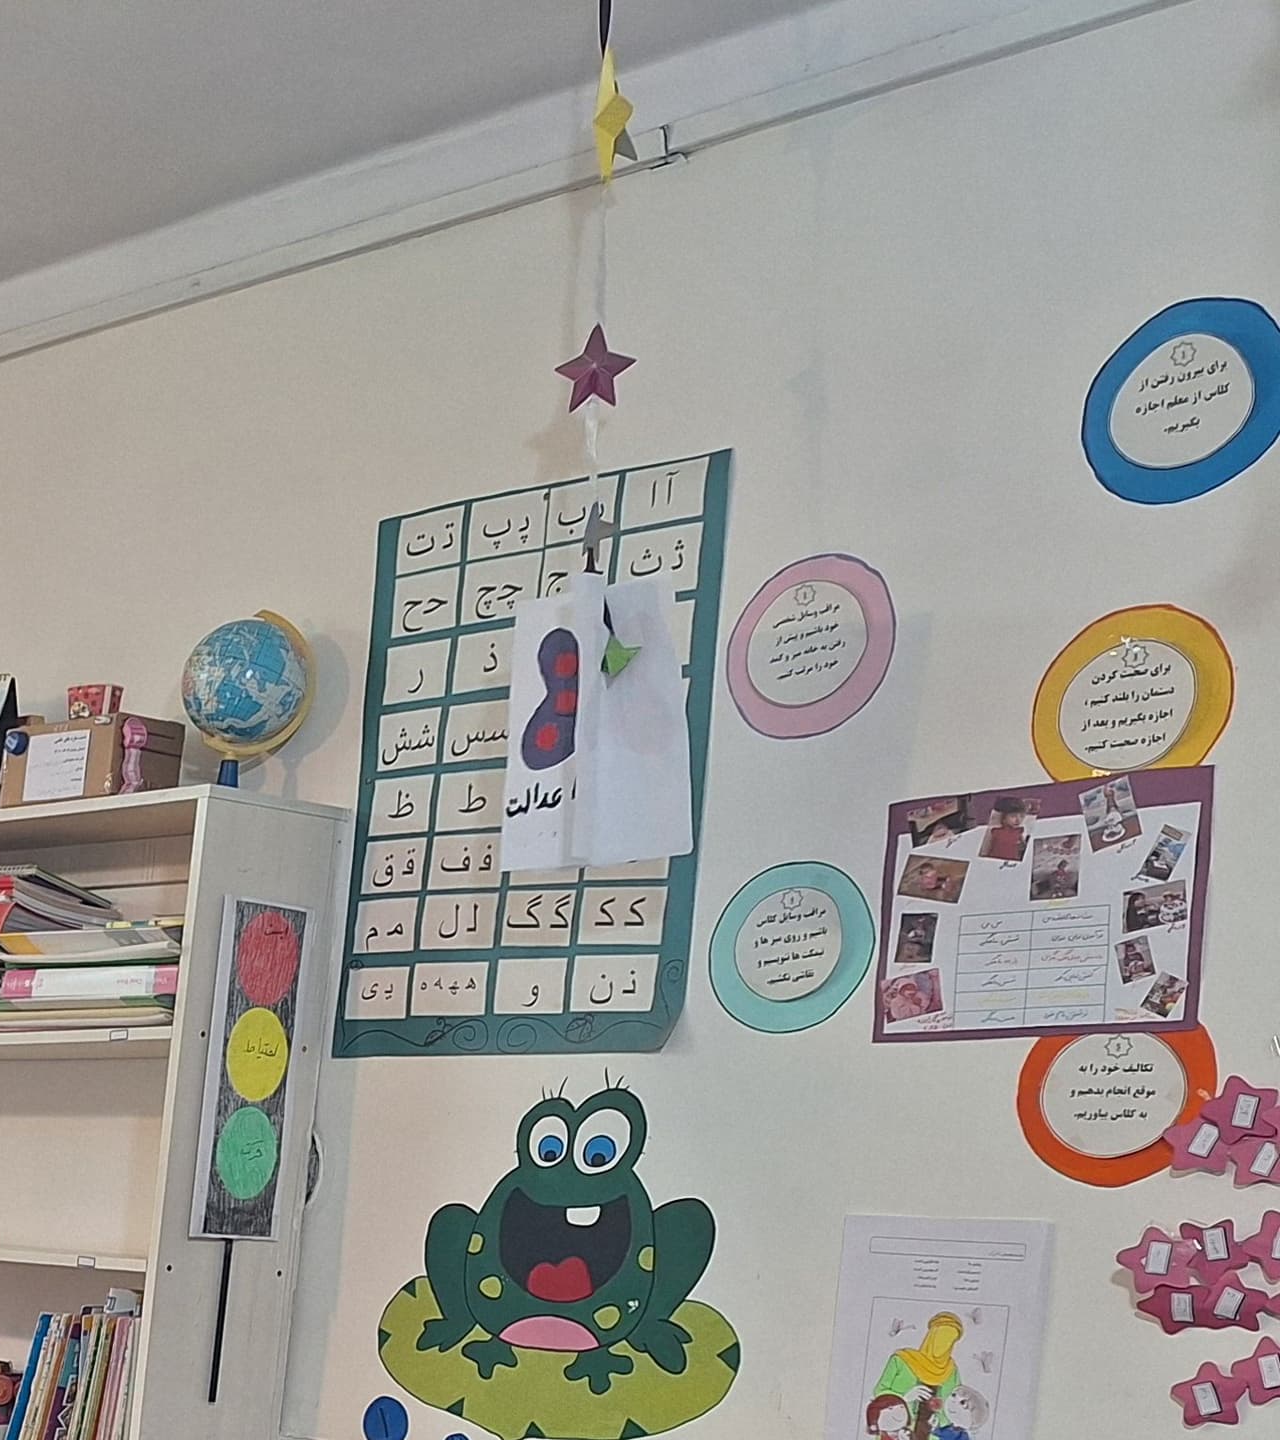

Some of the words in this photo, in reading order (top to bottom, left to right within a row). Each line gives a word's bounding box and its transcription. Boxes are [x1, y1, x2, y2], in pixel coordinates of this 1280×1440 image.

[1207, 360, 1227, 375] برای
[1151, 375, 1175, 389] رفتن
[1177, 367, 1204, 383] بیرون
[1139, 378, 1149, 392] از
[1204, 382, 1230, 402] کلاس
[1166, 395, 1189, 410] معلم
[1192, 390, 1201, 405] از
[1136, 399, 1165, 416] اجازه
[1150, 663, 1171, 677] برای
[1091, 670, 1118, 685] کردن
[1112, 692, 1129, 702] بلند
[1131, 690, 1140, 703] را
[1141, 686, 1174, 701] دستمان
[1090, 694, 1110, 708] کنیم
[1148, 708, 1173, 723] اجازه
[1081, 719, 1091, 732] از
[1111, 720, 1116, 729] و
[1110, 739, 1139, 748] صحبت
[1141, 732, 1166, 747] اجازه
[387, 789, 416, 820] ظ
[456, 782, 488, 815] ط
[754, 940, 759, 948] و
[803, 933, 807, 941] و
[758, 960, 762, 968] و
[525, 977, 540, 1006] و
[1090, 1063, 1098, 1076] را
[1101, 1065, 1120, 1075] خود
[1122, 1063, 1153, 1073] تکالیف
[1069, 1089, 1076, 1098] و
[1077, 1088, 1104, 1097] بدهیم
[1106, 1086, 1131, 1098] انجام
[1132, 1085, 1156, 1099] موقع
[1110, 1109, 1136, 1121] کلاس
